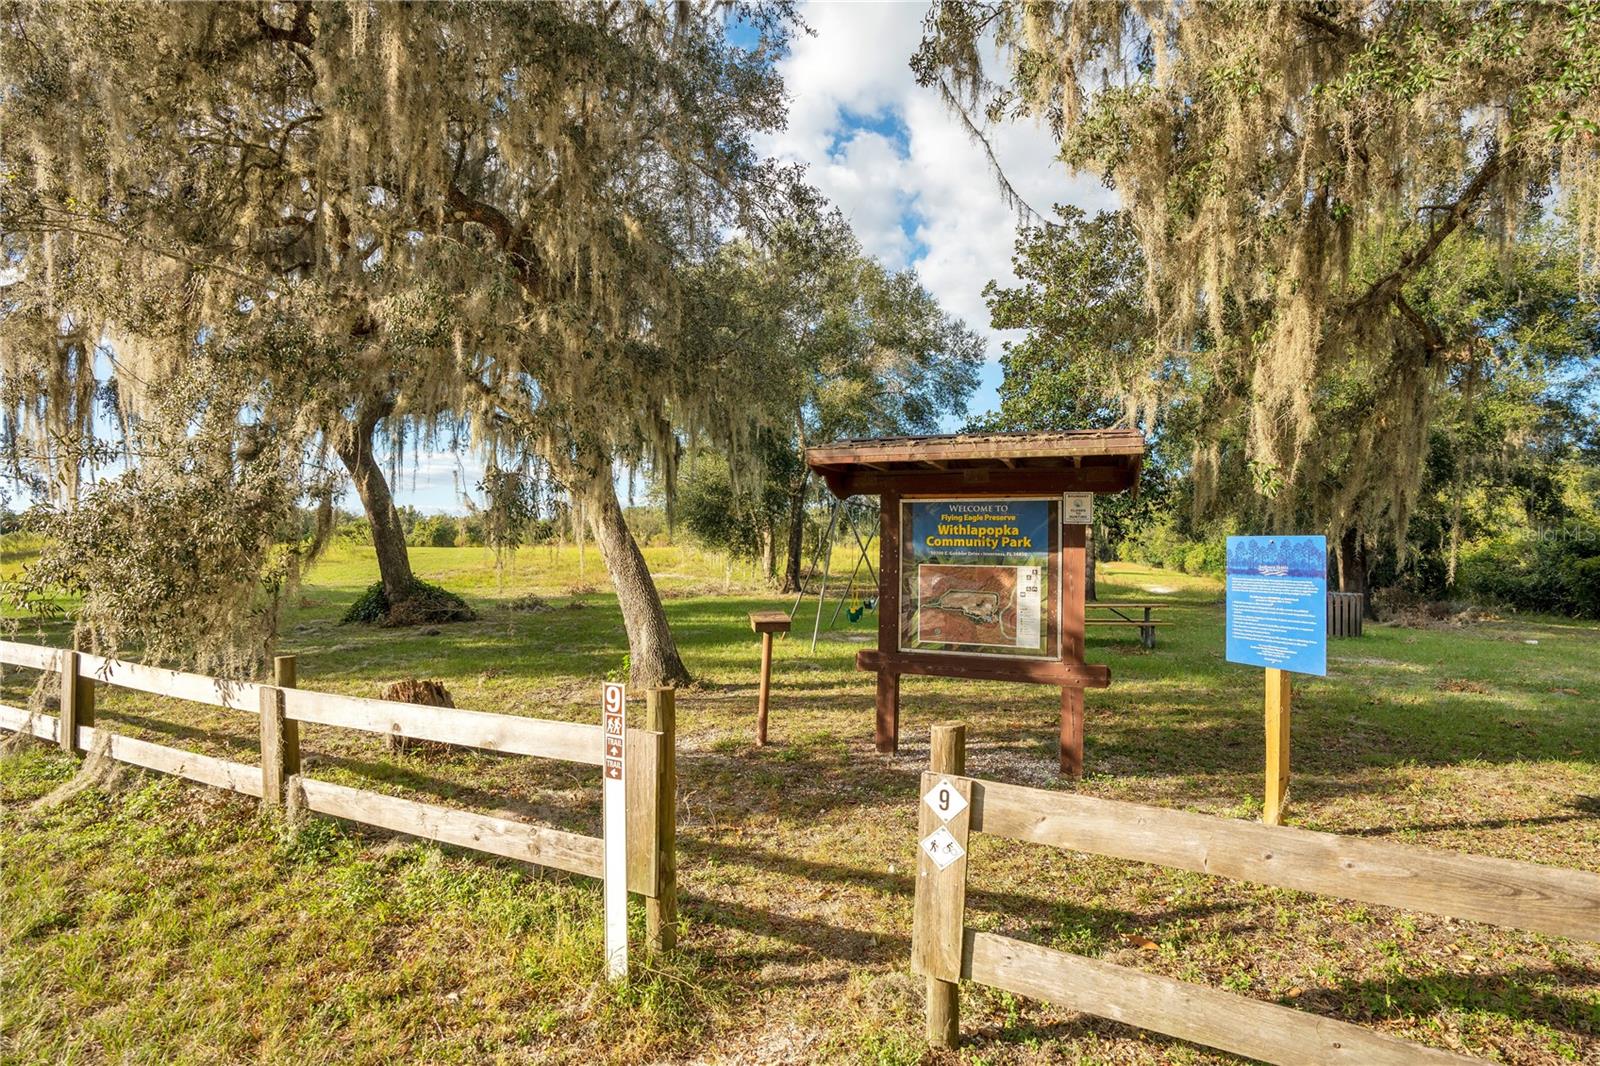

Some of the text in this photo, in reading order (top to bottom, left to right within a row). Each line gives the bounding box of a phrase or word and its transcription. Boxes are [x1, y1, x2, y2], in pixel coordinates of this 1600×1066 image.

[949, 504, 1009, 512] WELCOME TO
[941, 514, 963, 522] Flying
[964, 514, 983, 522] Eagle
[937, 524, 1019, 537] Withlapopka
[926, 536, 1031, 550] Community Park
[606, 685, 620, 712] 9
[607, 738, 622, 746] TRAIL
[607, 759, 622, 767] TRAIL
[939, 789, 950, 811] 9
